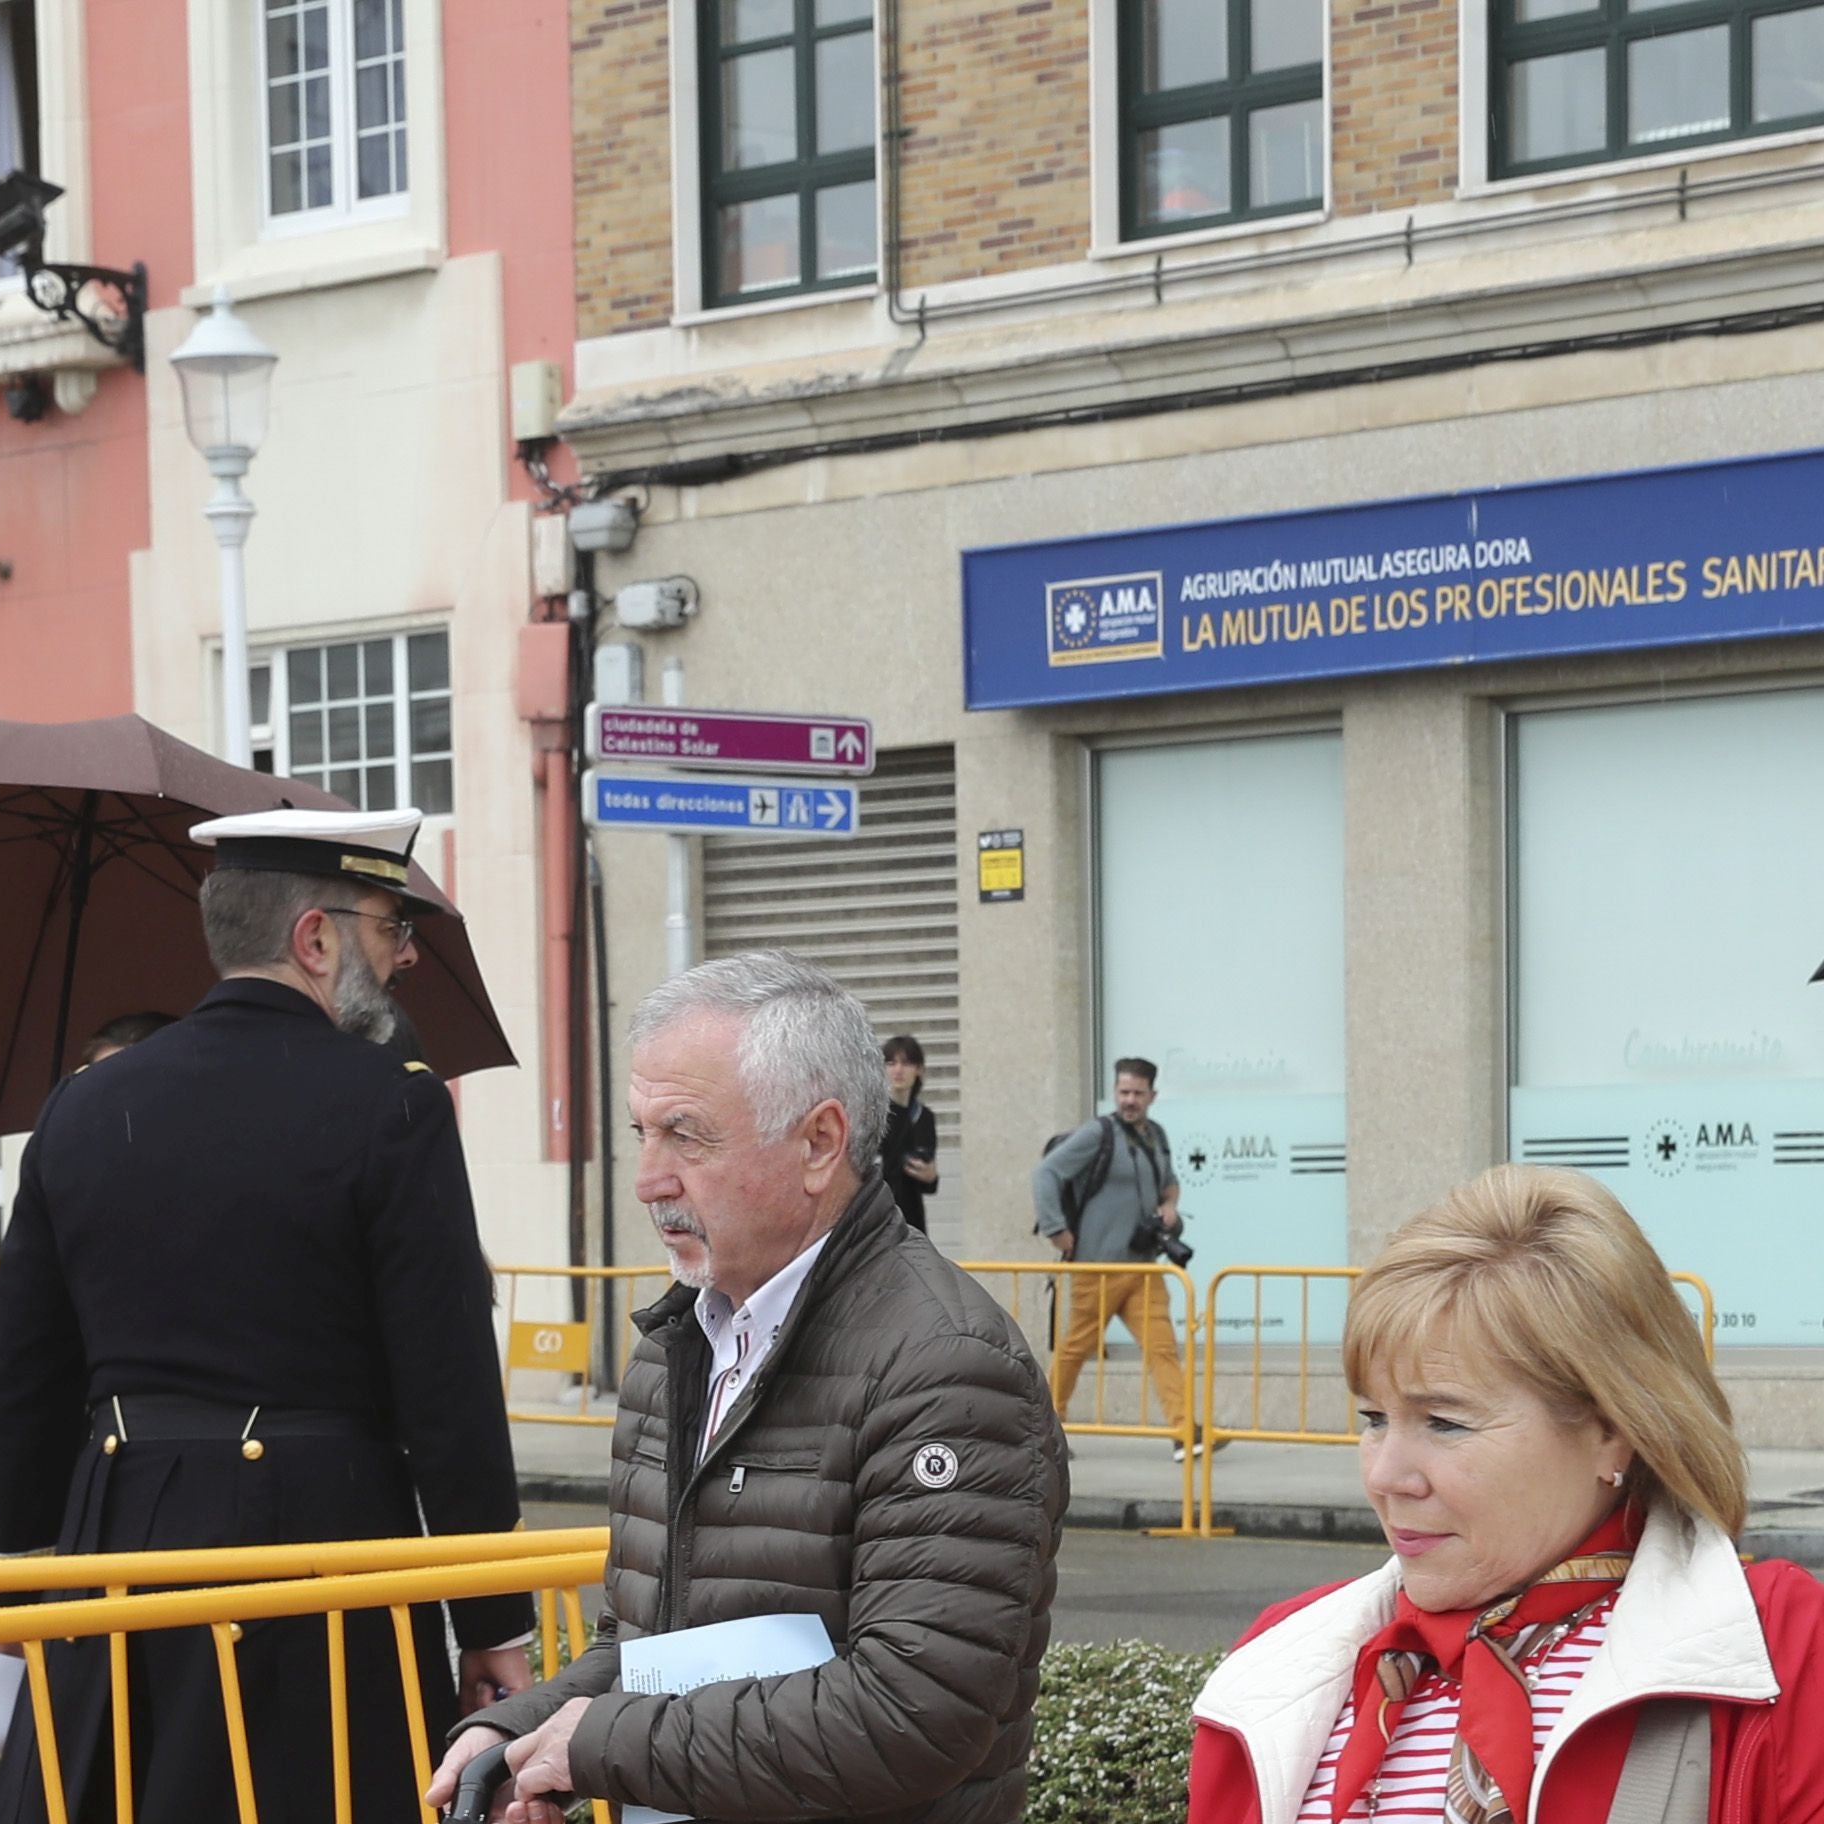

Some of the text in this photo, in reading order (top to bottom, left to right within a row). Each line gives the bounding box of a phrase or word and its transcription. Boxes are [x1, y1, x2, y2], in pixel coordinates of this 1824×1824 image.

[1180, 559, 1297, 602] AGRUPACIÓN
[1300, 555, 1379, 590] MUTUAL
[1182, 612, 1216, 652] LA
[1220, 600, 1324, 648] MUTUA
[1329, 595, 1368, 636] DE
[1373, 588, 1428, 632] LOS
[603, 717, 698, 737] ciudadela de
[603, 735, 720, 757] Celestino Solar
[603, 791, 745, 814] todas direcciones
[1695, 1122, 1759, 1147] A.M.A.
[1721, 1312, 1739, 1328] 30
[1741, 1312, 1756, 1328] 10
[930, 1458, 942, 1472] R
